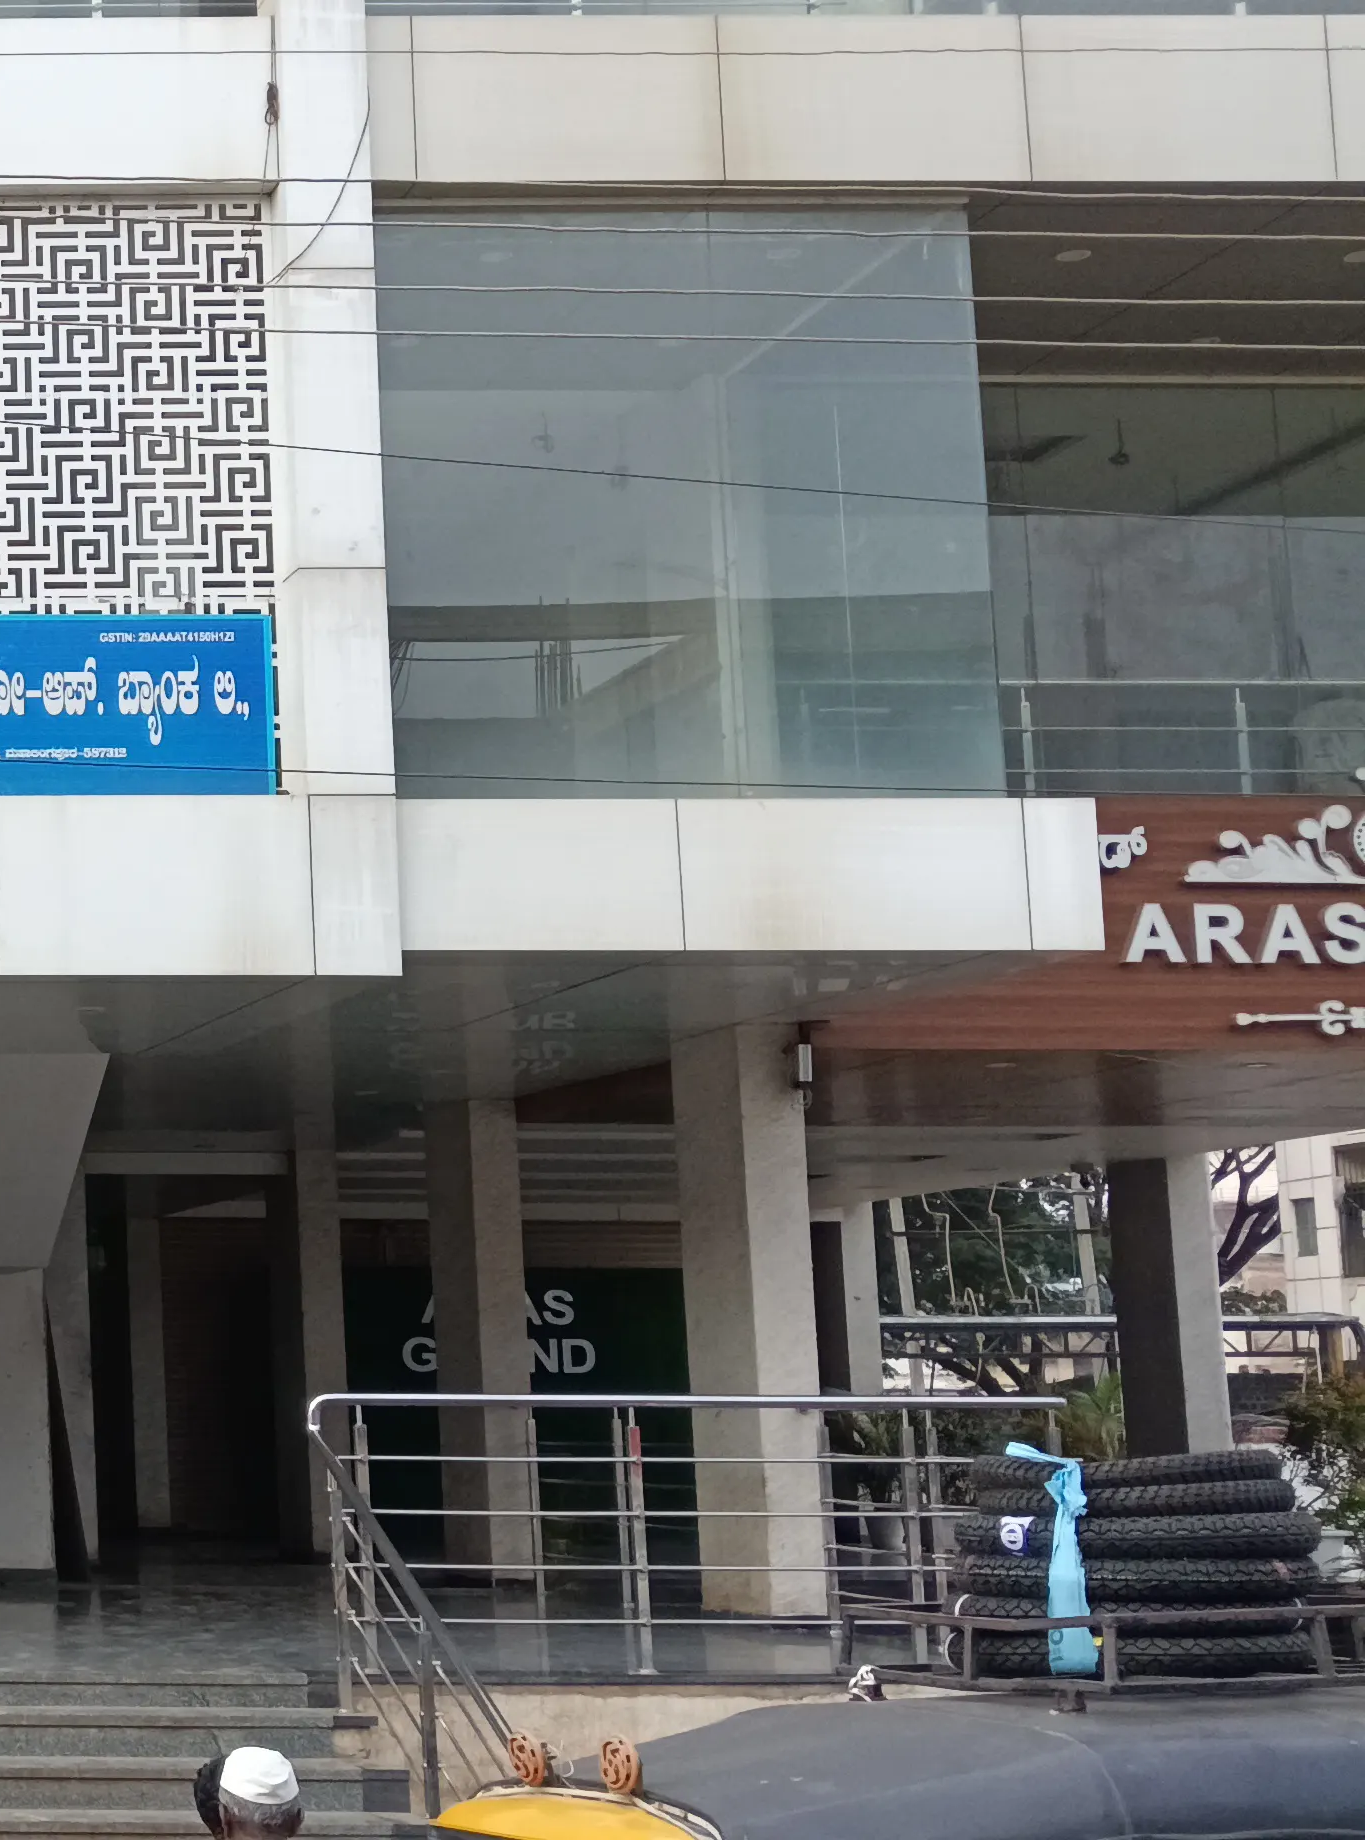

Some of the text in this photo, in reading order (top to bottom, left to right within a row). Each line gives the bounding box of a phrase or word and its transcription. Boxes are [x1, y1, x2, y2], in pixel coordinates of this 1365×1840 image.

[99, 632, 136, 643] GSTIN:
[117, 655, 200, 746] ಬ್ಯಾಂಕ
[1124, 902, 1365, 965] ARAS
[402, 1336, 596, 1374] GND
